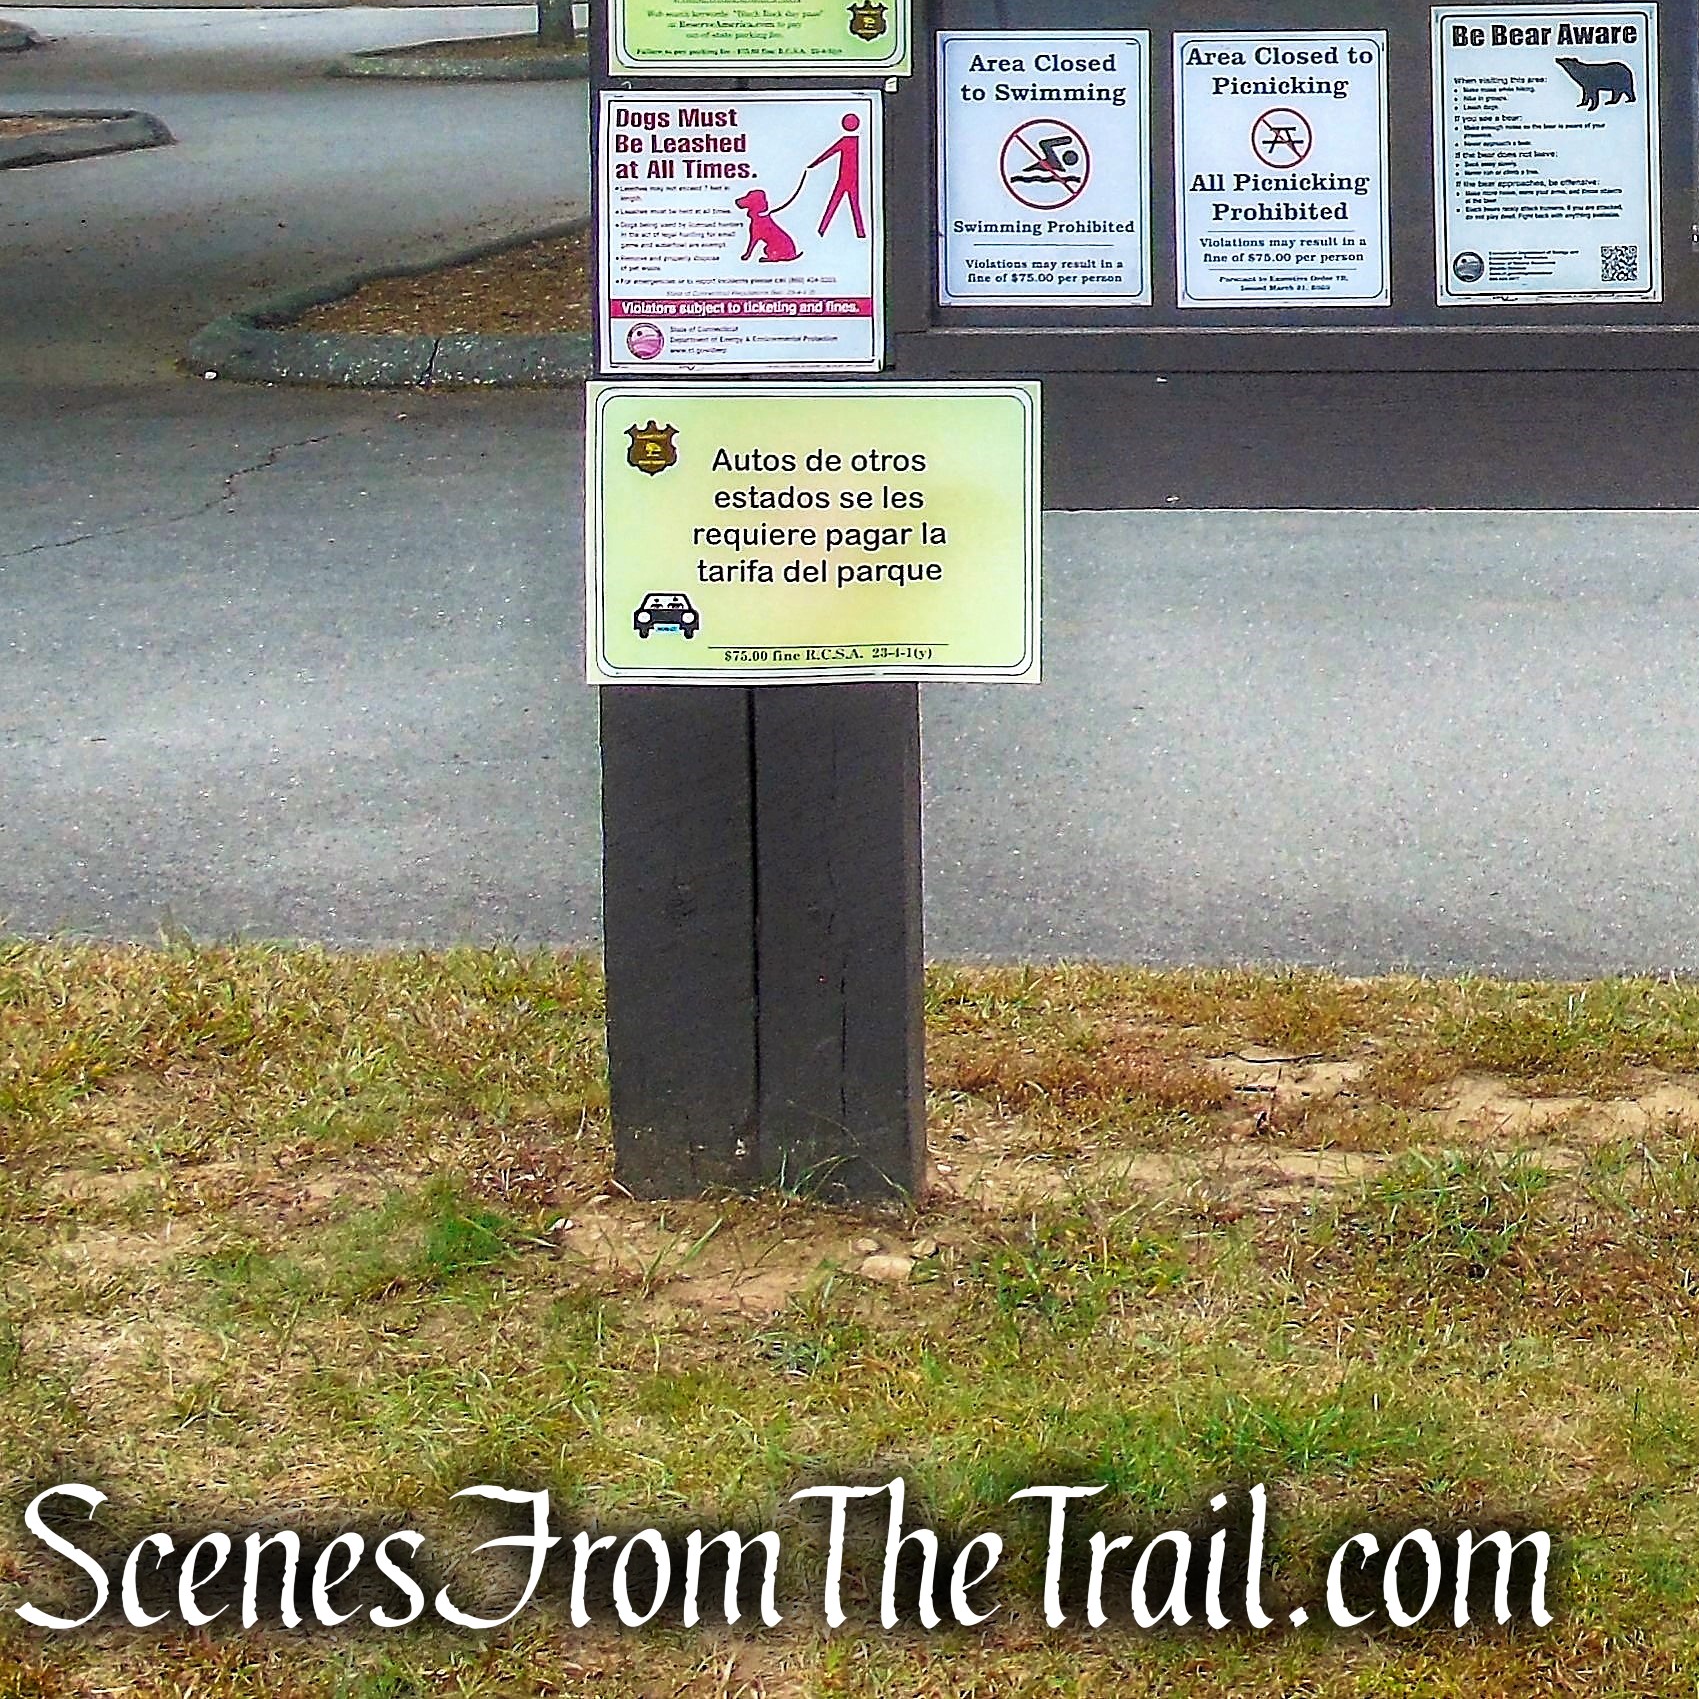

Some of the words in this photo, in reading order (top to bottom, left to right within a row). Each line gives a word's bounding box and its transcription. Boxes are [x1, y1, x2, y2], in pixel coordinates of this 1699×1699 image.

[1452, 26, 1485, 46] Be
[1492, 25, 1551, 46] Bear
[1557, 24, 1637, 45] Aware
[969, 55, 1025, 72] Area
[1035, 54, 1116, 72] Closed
[1186, 48, 1246, 65] Area
[1255, 47, 1339, 65] Closed
[1349, 47, 1373, 64] to
[1212, 77, 1349, 98] Picnicking
[1479, 77, 1508, 85] visiting
[961, 85, 985, 101] to
[995, 83, 1126, 106] Swimming
[616, 109, 669, 130] Dogs
[679, 108, 738, 127] Must
[616, 134, 642, 153] Be
[652, 134, 746, 153] Leashed
[616, 161, 638, 179] at
[647, 160, 674, 178] All
[682, 160, 757, 178] Times.
[1189, 174, 1225, 191] All
[1233, 173, 1370, 195] Picnicking
[1212, 202, 1348, 220] Prohibited
[954, 221, 1042, 236] Swimming
[1048, 220, 1135, 232] Prohibited
[1200, 238, 1264, 247] Violations
[1270, 240, 1296, 249] may
[1300, 237, 1338, 246] result
[1342, 237, 1355, 245] in
[966, 259, 1027, 268] Violations
[1032, 262, 1057, 271] may
[1062, 260, 1096, 268] result
[1101, 260, 1112, 268] in
[1204, 253, 1227, 262] fine
[1232, 253, 1244, 262] of
[1248, 253, 1291, 261] $75.00
[1296, 255, 1316, 264] per
[1320, 254, 1363, 263] person
[968, 274, 990, 282] fine
[995, 273, 1008, 282] of
[1012, 273, 1053, 283] $75.00
[1058, 276, 1077, 284] per
[1082, 276, 1122, 284] person
[622, 302, 676, 314] Violators
[680, 302, 724, 315] subject
[728, 303, 741, 314] to
[744, 302, 797, 315] ticketing
[800, 301, 823, 313] and
[826, 301, 860, 313] fines.
[712, 448, 796, 471] Autos
[806, 449, 841, 471] de
[851, 449, 926, 471] otros
[715, 486, 830, 508] estados
[840, 492, 872, 508] se
[884, 486, 923, 508] les
[694, 523, 816, 551] requiere
[827, 528, 912, 552] pagar
[922, 522, 946, 544] la
[697, 560, 773, 582] tarifa
[784, 560, 826, 582] del
[838, 564, 941, 588] parque
[724, 649, 768, 661] $75.00
[772, 649, 800, 661] fine
[806, 648, 863, 660] R.C.S.A.
